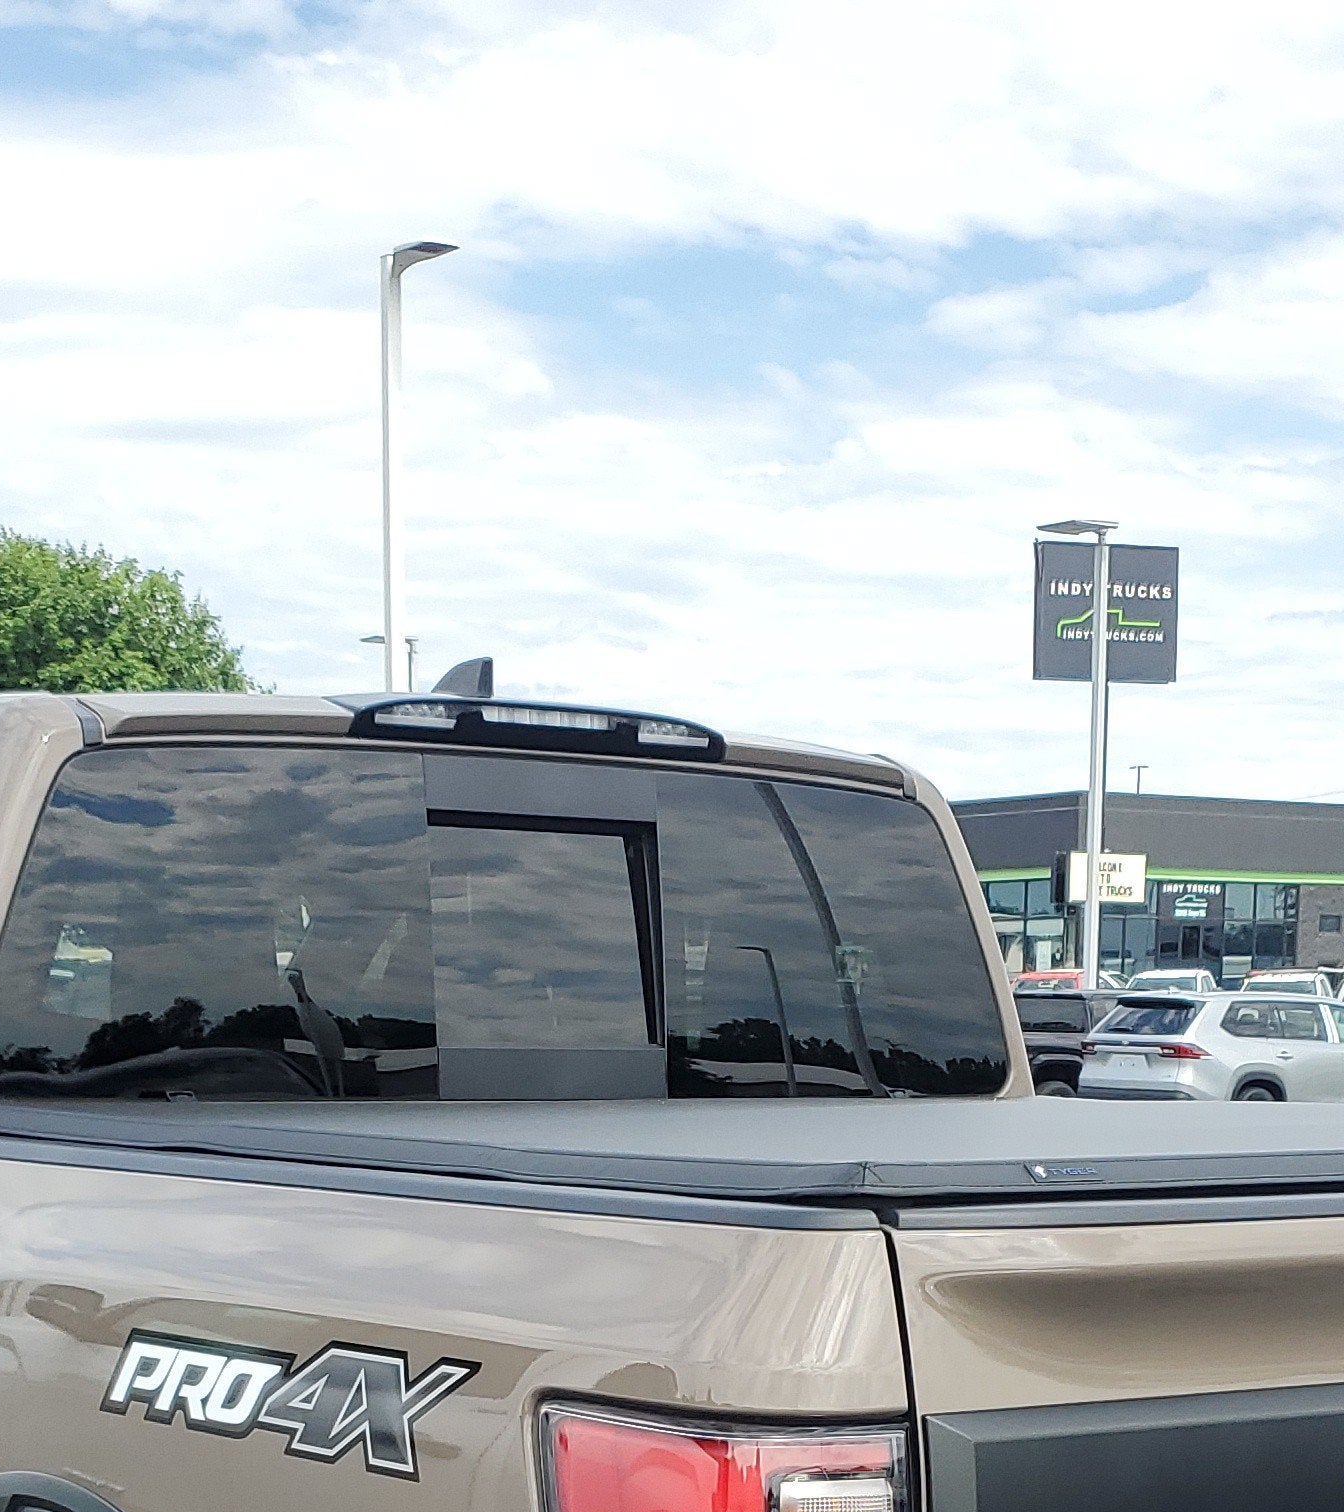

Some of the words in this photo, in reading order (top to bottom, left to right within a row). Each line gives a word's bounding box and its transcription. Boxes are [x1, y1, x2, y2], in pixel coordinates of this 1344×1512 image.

[1049, 582, 1093, 596] INDY
[1062, 629, 1164, 642] INDYTUCKS.COM
[1106, 886, 1133, 896] TRUCKS
